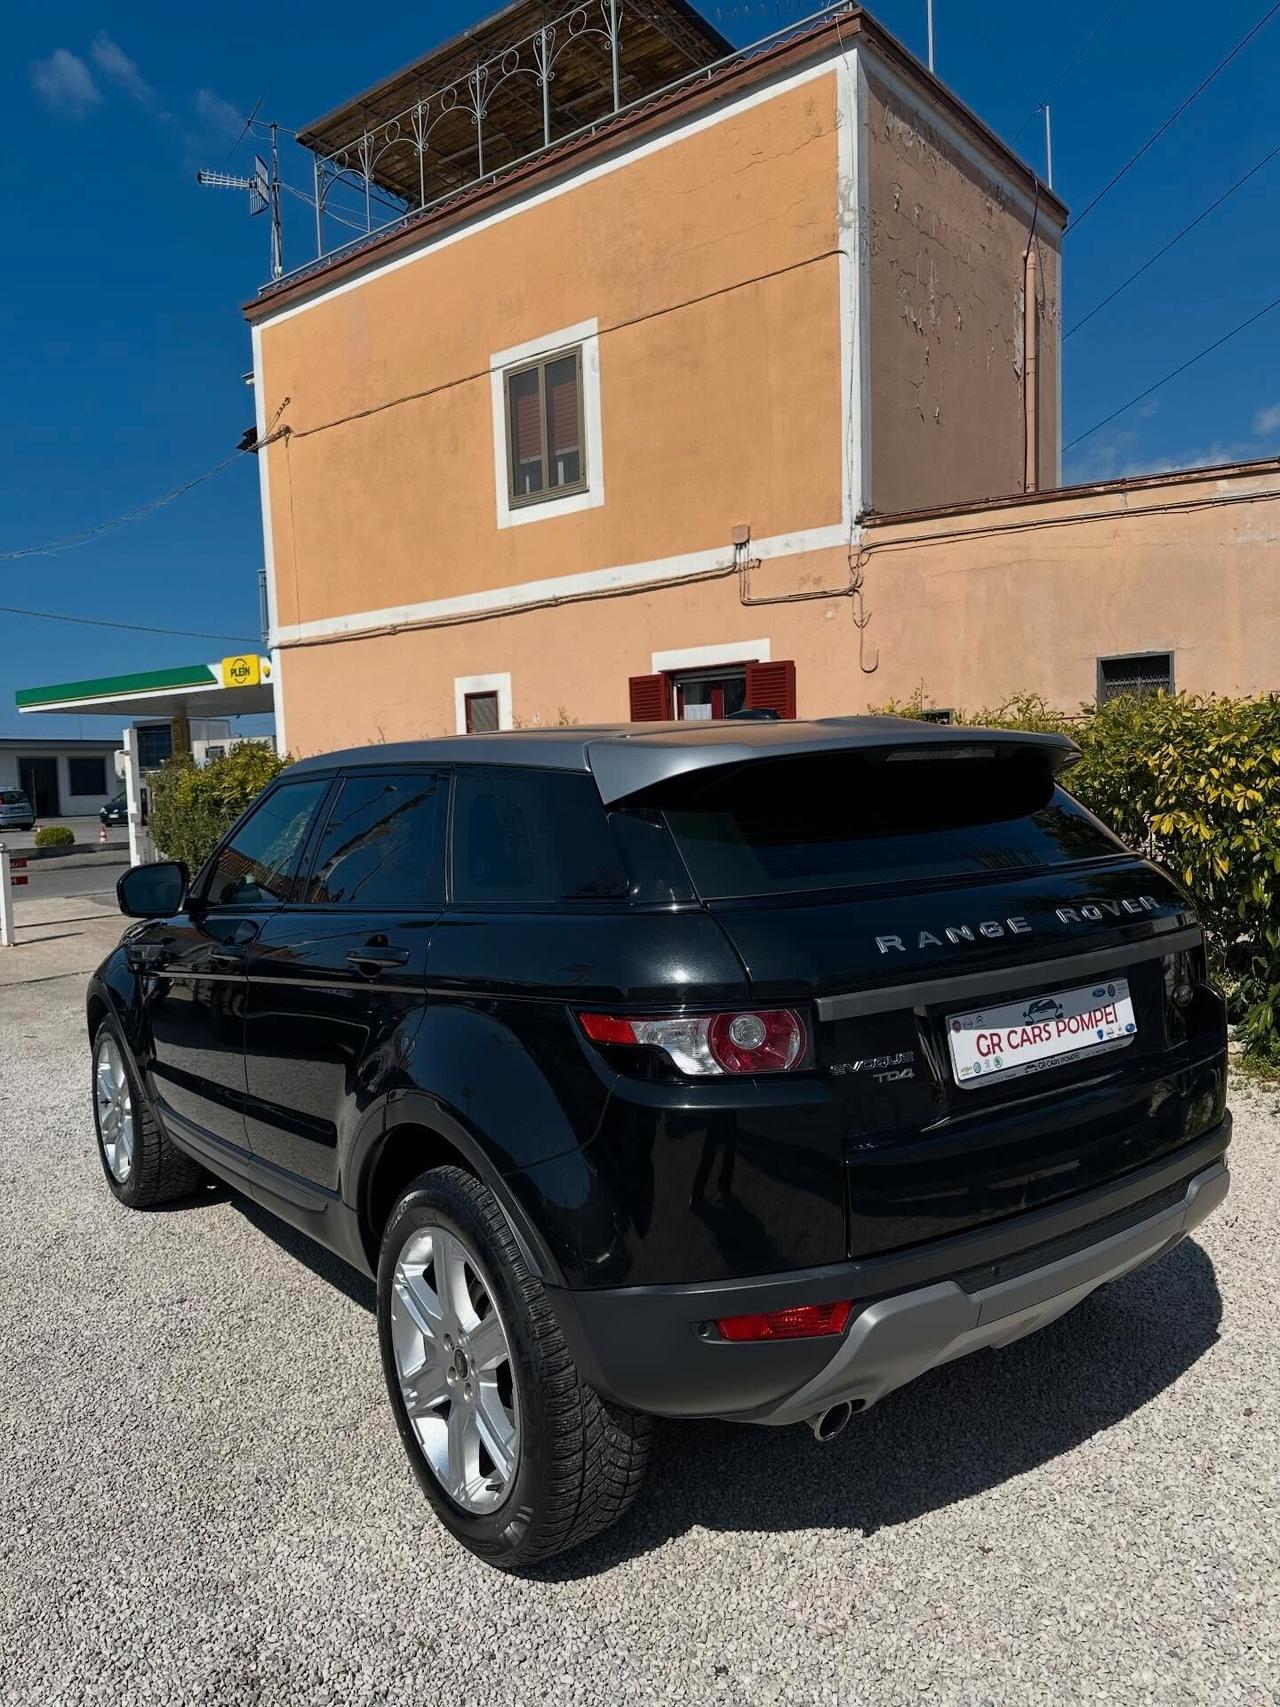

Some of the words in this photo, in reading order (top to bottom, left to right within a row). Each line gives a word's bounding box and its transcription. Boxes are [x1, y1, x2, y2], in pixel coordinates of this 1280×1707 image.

[230, 664, 250, 678] PLEIN
[875, 916, 1032, 954] RANGE
[1055, 895, 1160, 924] ROVER
[976, 1032, 1004, 1057] GR
[1007, 1023, 1051, 1050] CARS
[1055, 1002, 1118, 1038] POMPEI
[830, 1051, 914, 1076] EVOQUE
[1046, 1057, 1061, 1067] CARS
[872, 1067, 916, 1084] TD4
